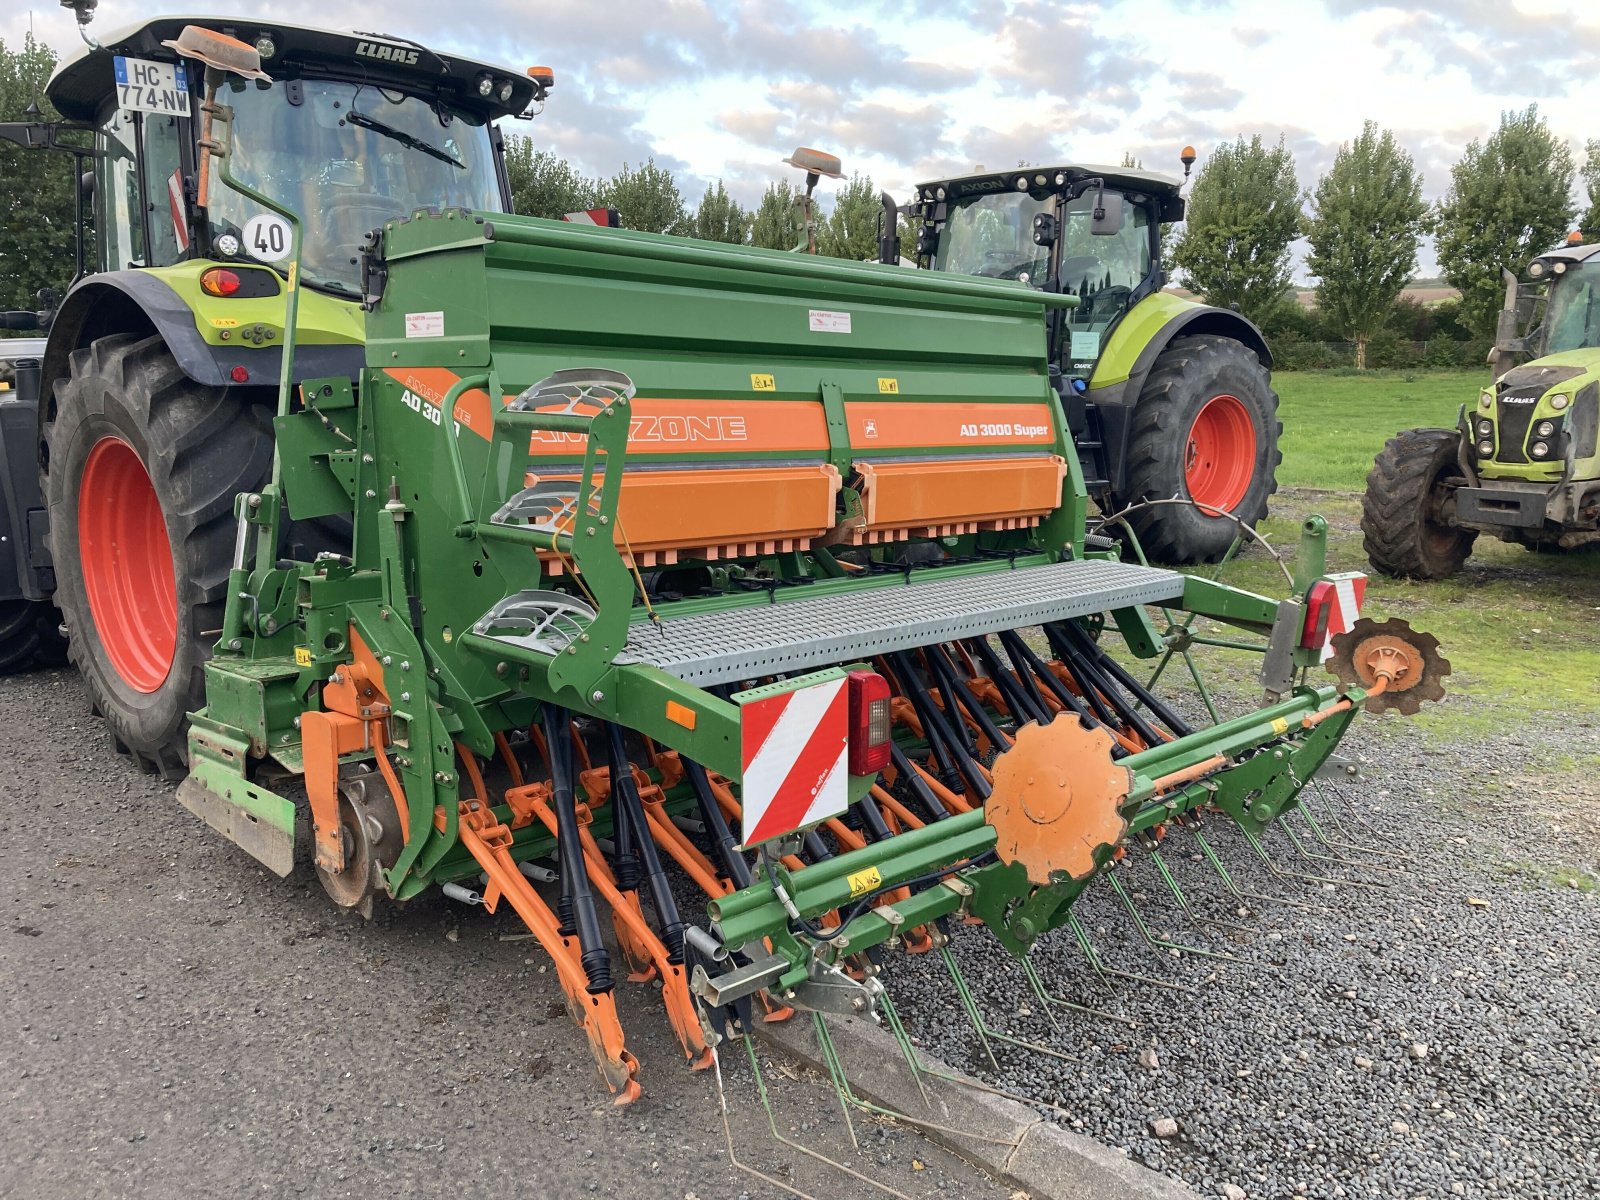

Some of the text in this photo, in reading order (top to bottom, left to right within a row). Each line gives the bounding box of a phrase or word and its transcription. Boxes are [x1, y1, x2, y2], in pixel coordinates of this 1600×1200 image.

[355, 41, 420, 65] CLAAS
[176, 80, 187, 90] 03
[118, 84, 187, 112] 774-NW
[961, 180, 1005, 192] AXION
[254, 223, 284, 253] 40
[401, 389, 421, 413] AD
[405, 375, 472, 426] AMAZNE
[1503, 396, 1536, 404] CLAAS
[960, 423, 1048, 439] AD 3000 Super
